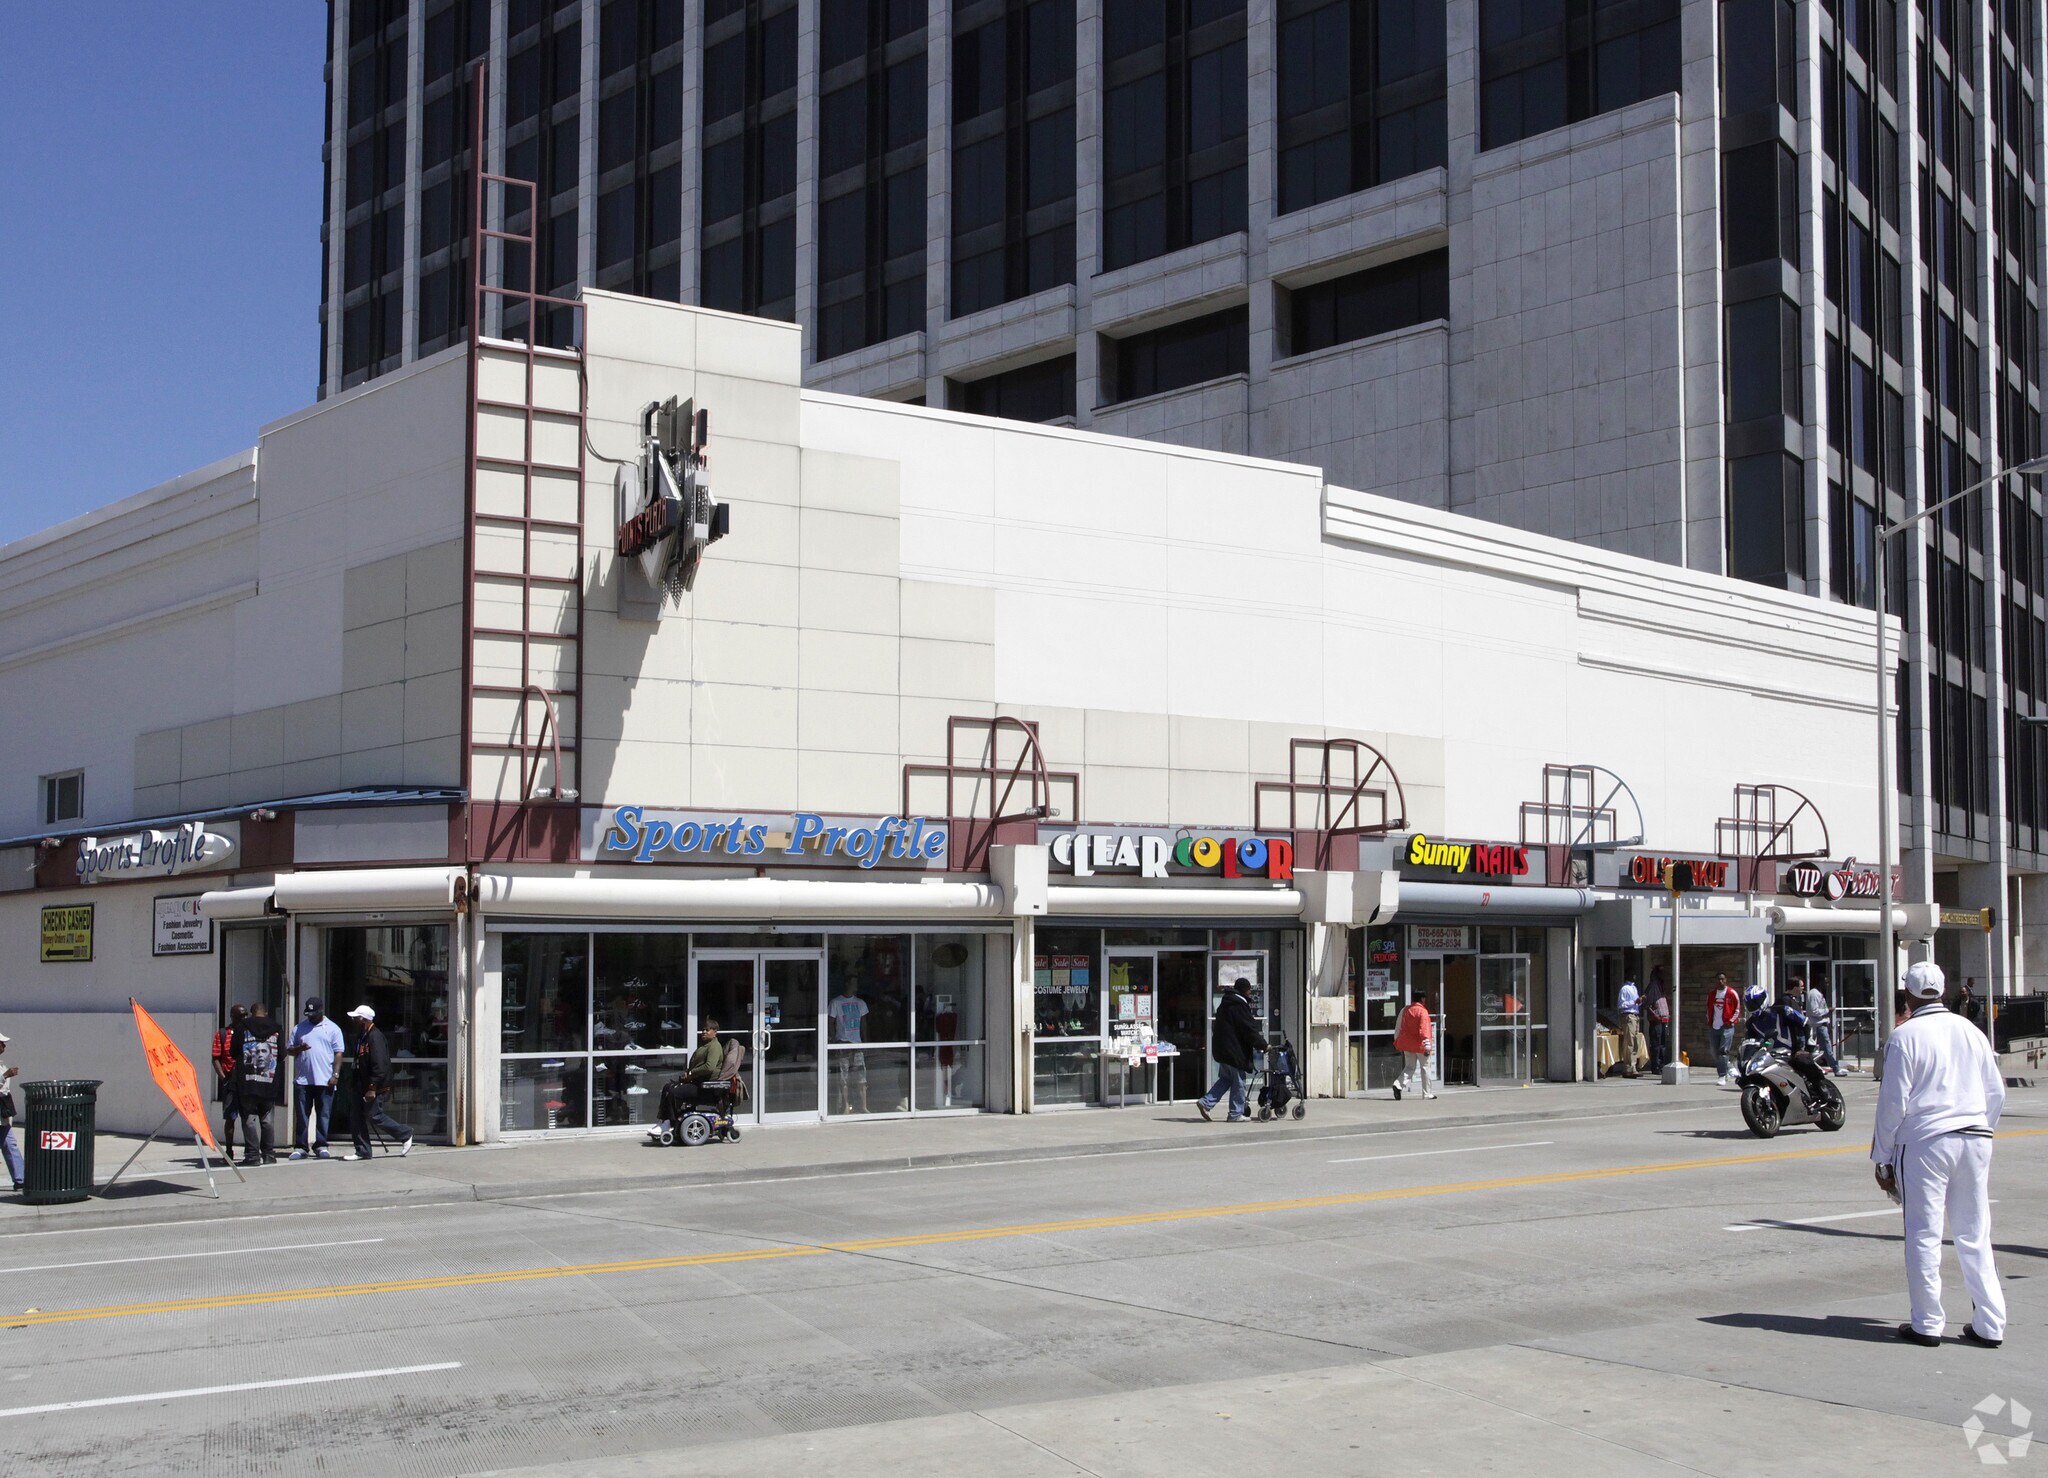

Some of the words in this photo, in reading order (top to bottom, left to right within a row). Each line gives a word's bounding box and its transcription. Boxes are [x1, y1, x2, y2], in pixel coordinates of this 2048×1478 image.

[607, 805, 769, 862] Sports
[785, 812, 947, 869] Profile
[76, 837, 133, 883] Sports
[136, 821, 207, 874] Profile
[1052, 834, 1169, 878] CLEAR
[1174, 836, 1294, 880] COLOR
[1407, 833, 1472, 873] Sunny
[1794, 867, 1821, 893] VIP
[44, 911, 66, 931] CHECKS
[68, 909, 90, 930] CASHED
[163, 920, 181, 929] Fashion
[182, 919, 203, 928] Jewelry
[172, 931, 194, 940] Cosmetic
[158, 943, 176, 951] Fashion
[177, 942, 208, 951] Accessories
[1382, 941, 1397, 951] SPA
[1053, 958, 1069, 968] Sale
[1071, 958, 1088, 968] Sale
[1034, 985, 1062, 995] COSTUME
[1063, 985, 1089, 994] JEWELRY
